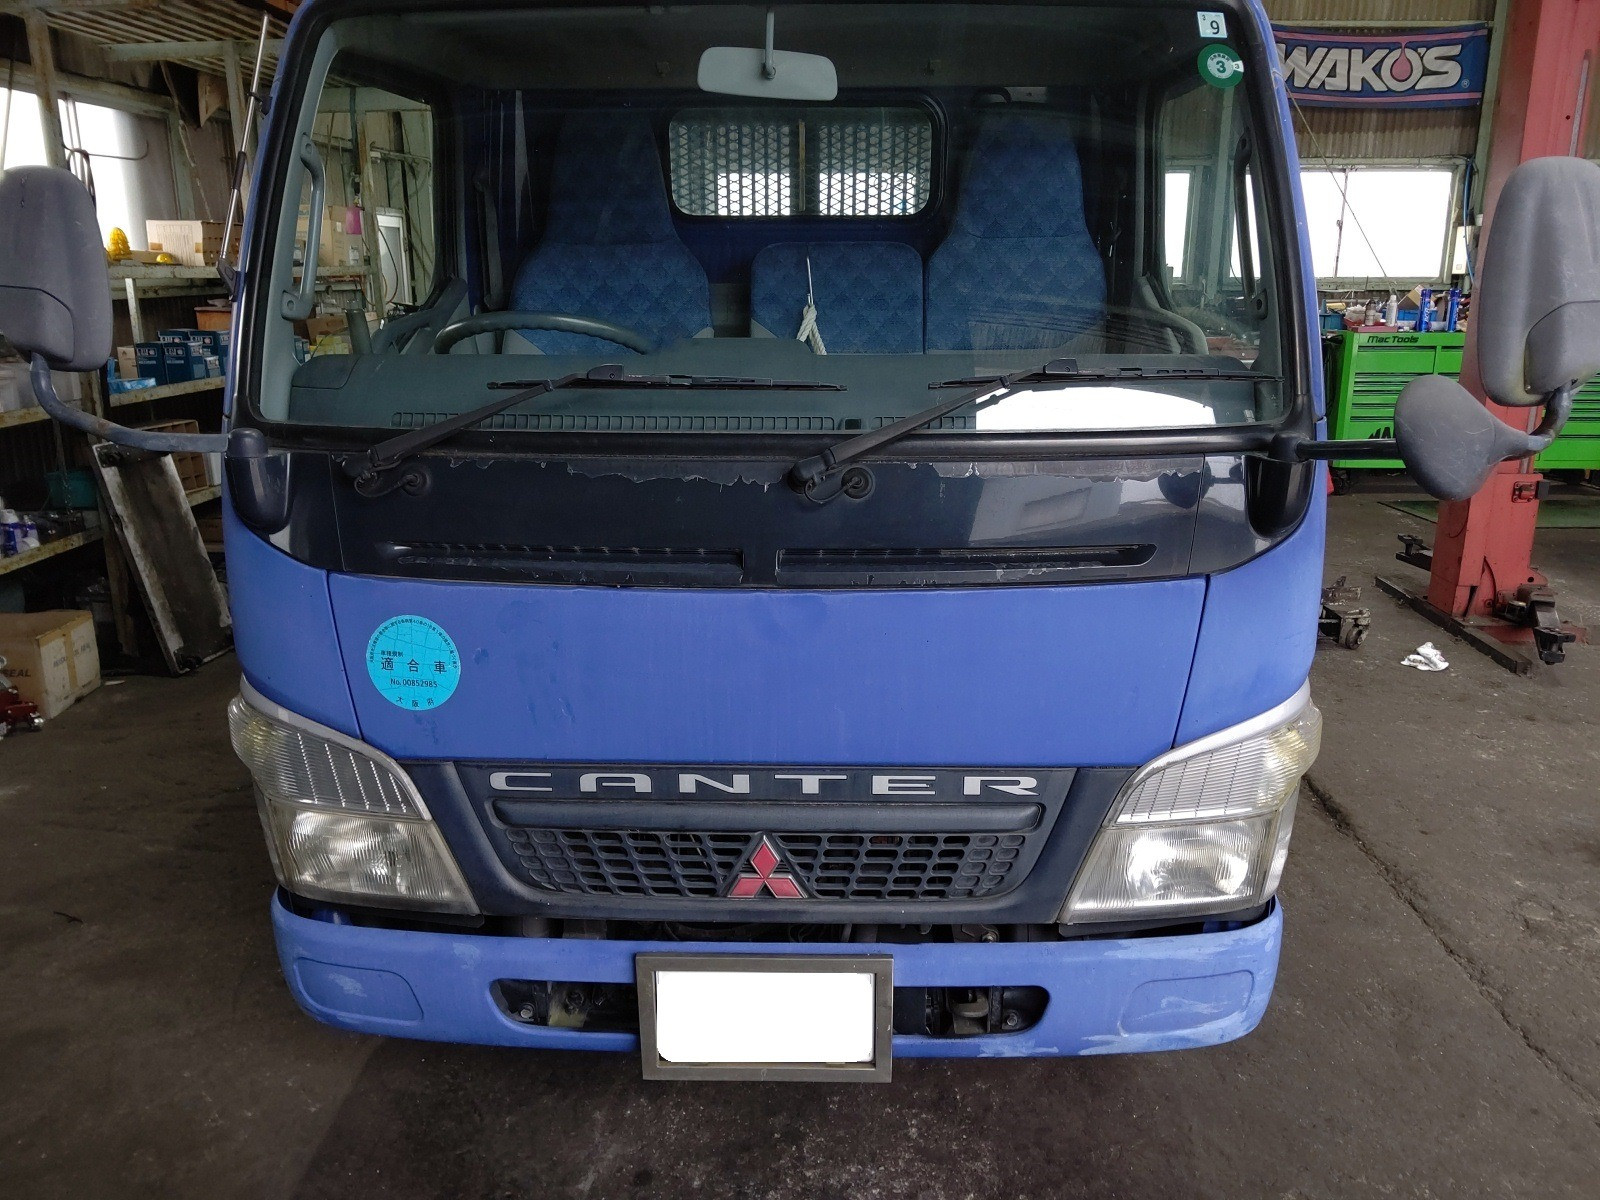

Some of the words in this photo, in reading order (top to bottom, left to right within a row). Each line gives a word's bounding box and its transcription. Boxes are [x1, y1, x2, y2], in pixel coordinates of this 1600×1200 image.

[1210, 20, 1220, 34] 9
[1216, 60, 1227, 73] 3
[1277, 43, 1462, 92] WAKO'S
[1367, 335, 1389, 344] Mac
[1392, 335, 1419, 344] Tools
[381, 657, 448, 674] 適合車
[488, 772, 1041, 797] CANTER
